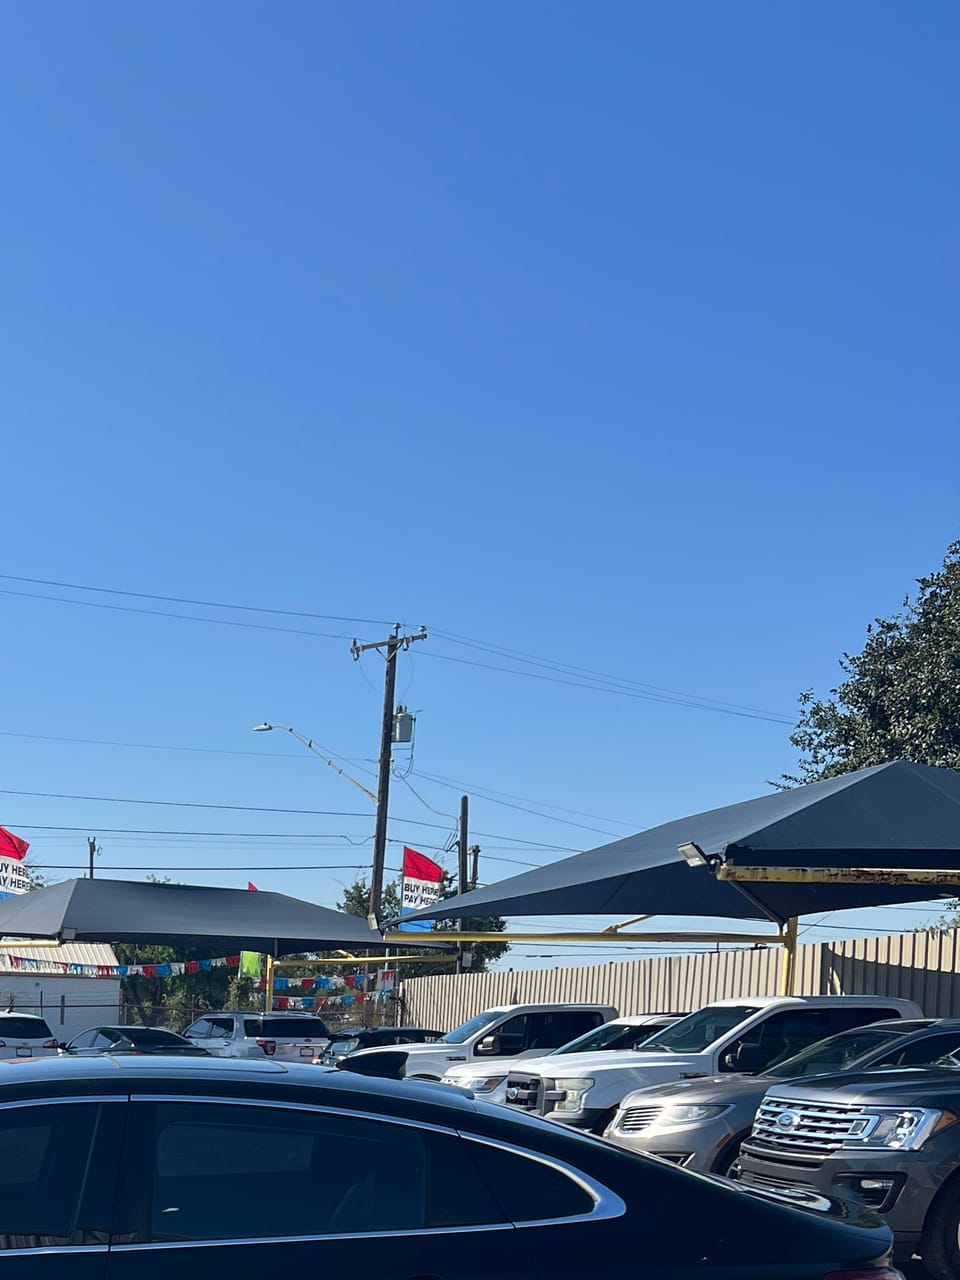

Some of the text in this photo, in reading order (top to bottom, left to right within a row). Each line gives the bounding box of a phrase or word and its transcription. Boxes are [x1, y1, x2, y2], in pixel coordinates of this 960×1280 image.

[12, 864, 30, 879] HERE
[10, 878, 30, 891] HERE
[404, 883, 420, 893] BUY
[404, 894, 418, 904] PAY
